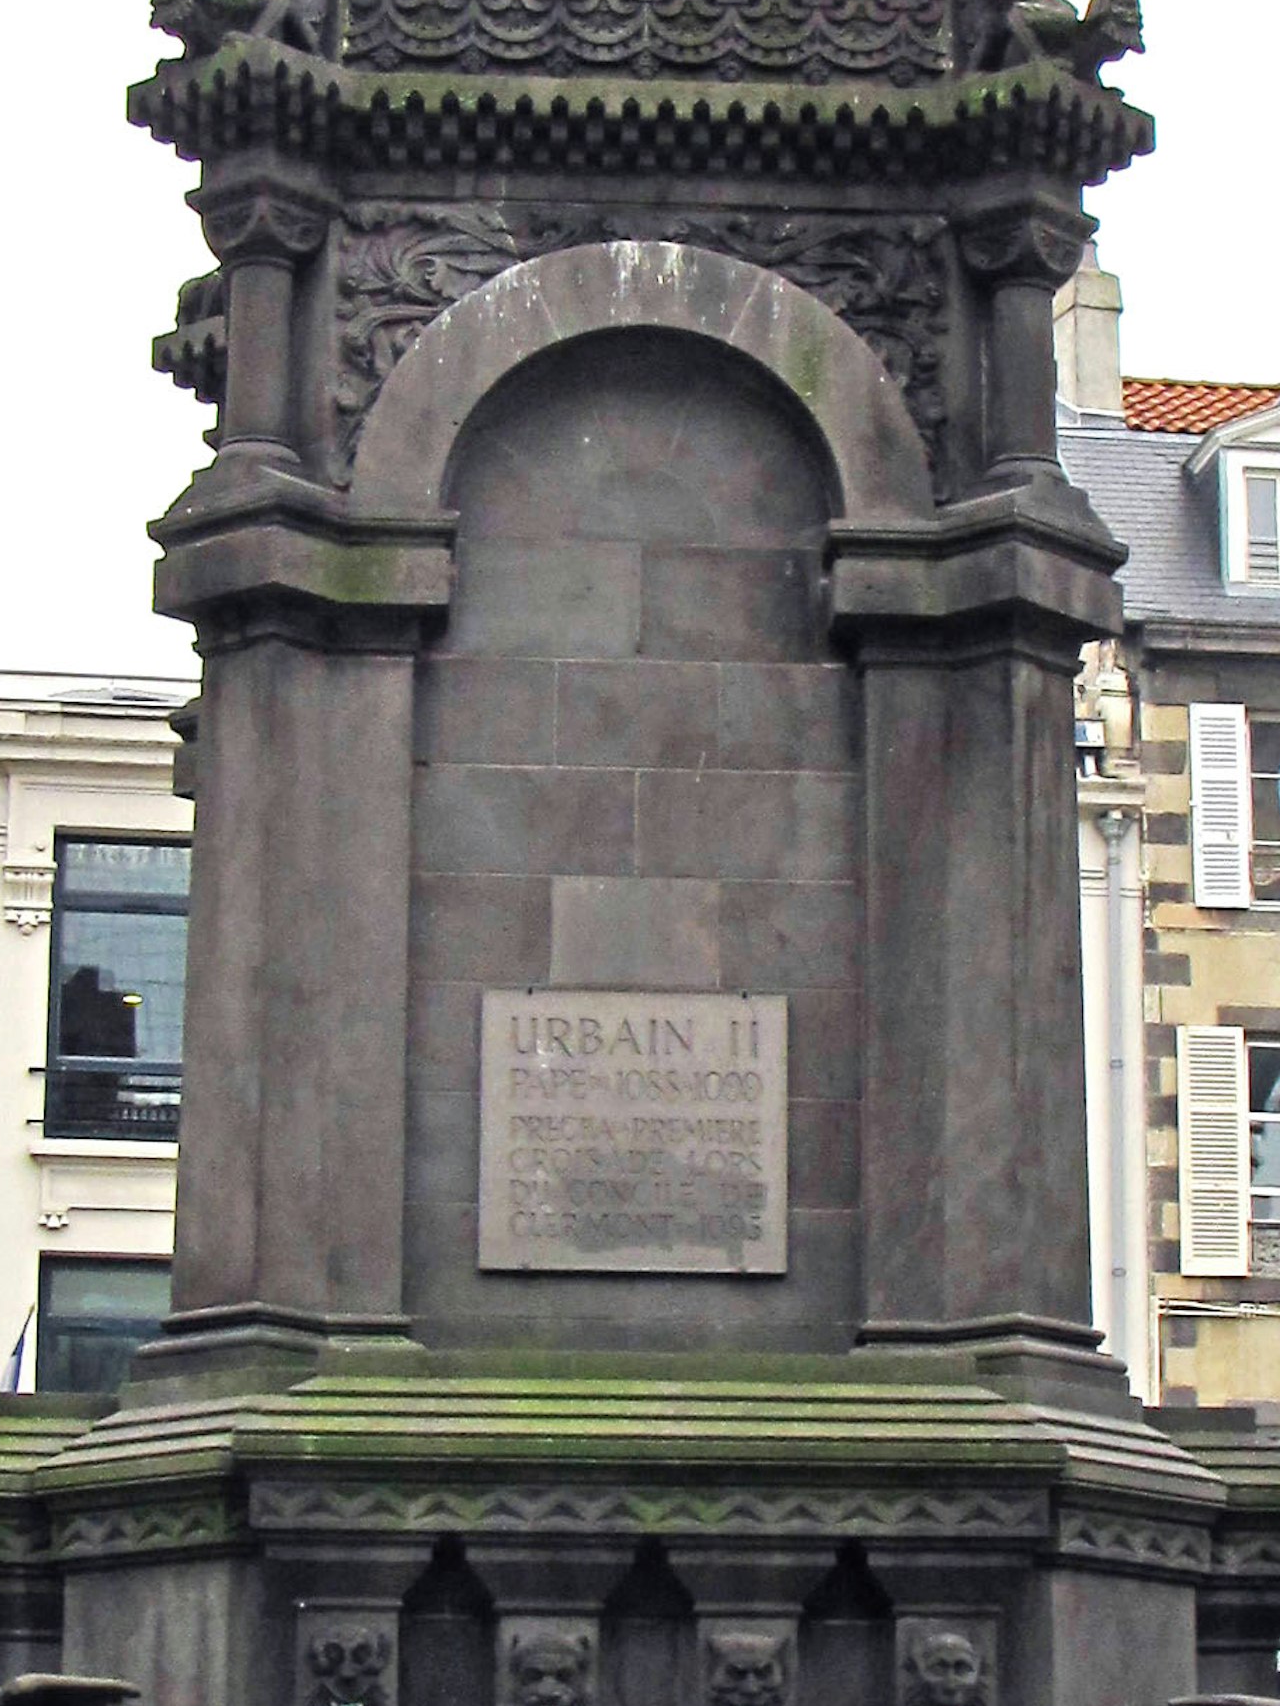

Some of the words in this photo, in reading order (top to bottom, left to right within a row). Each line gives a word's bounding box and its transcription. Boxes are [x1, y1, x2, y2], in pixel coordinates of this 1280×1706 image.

[510, 1016, 694, 1058] URBAIN
[729, 1020, 759, 1058] II
[510, 1067, 587, 1100] PAPE
